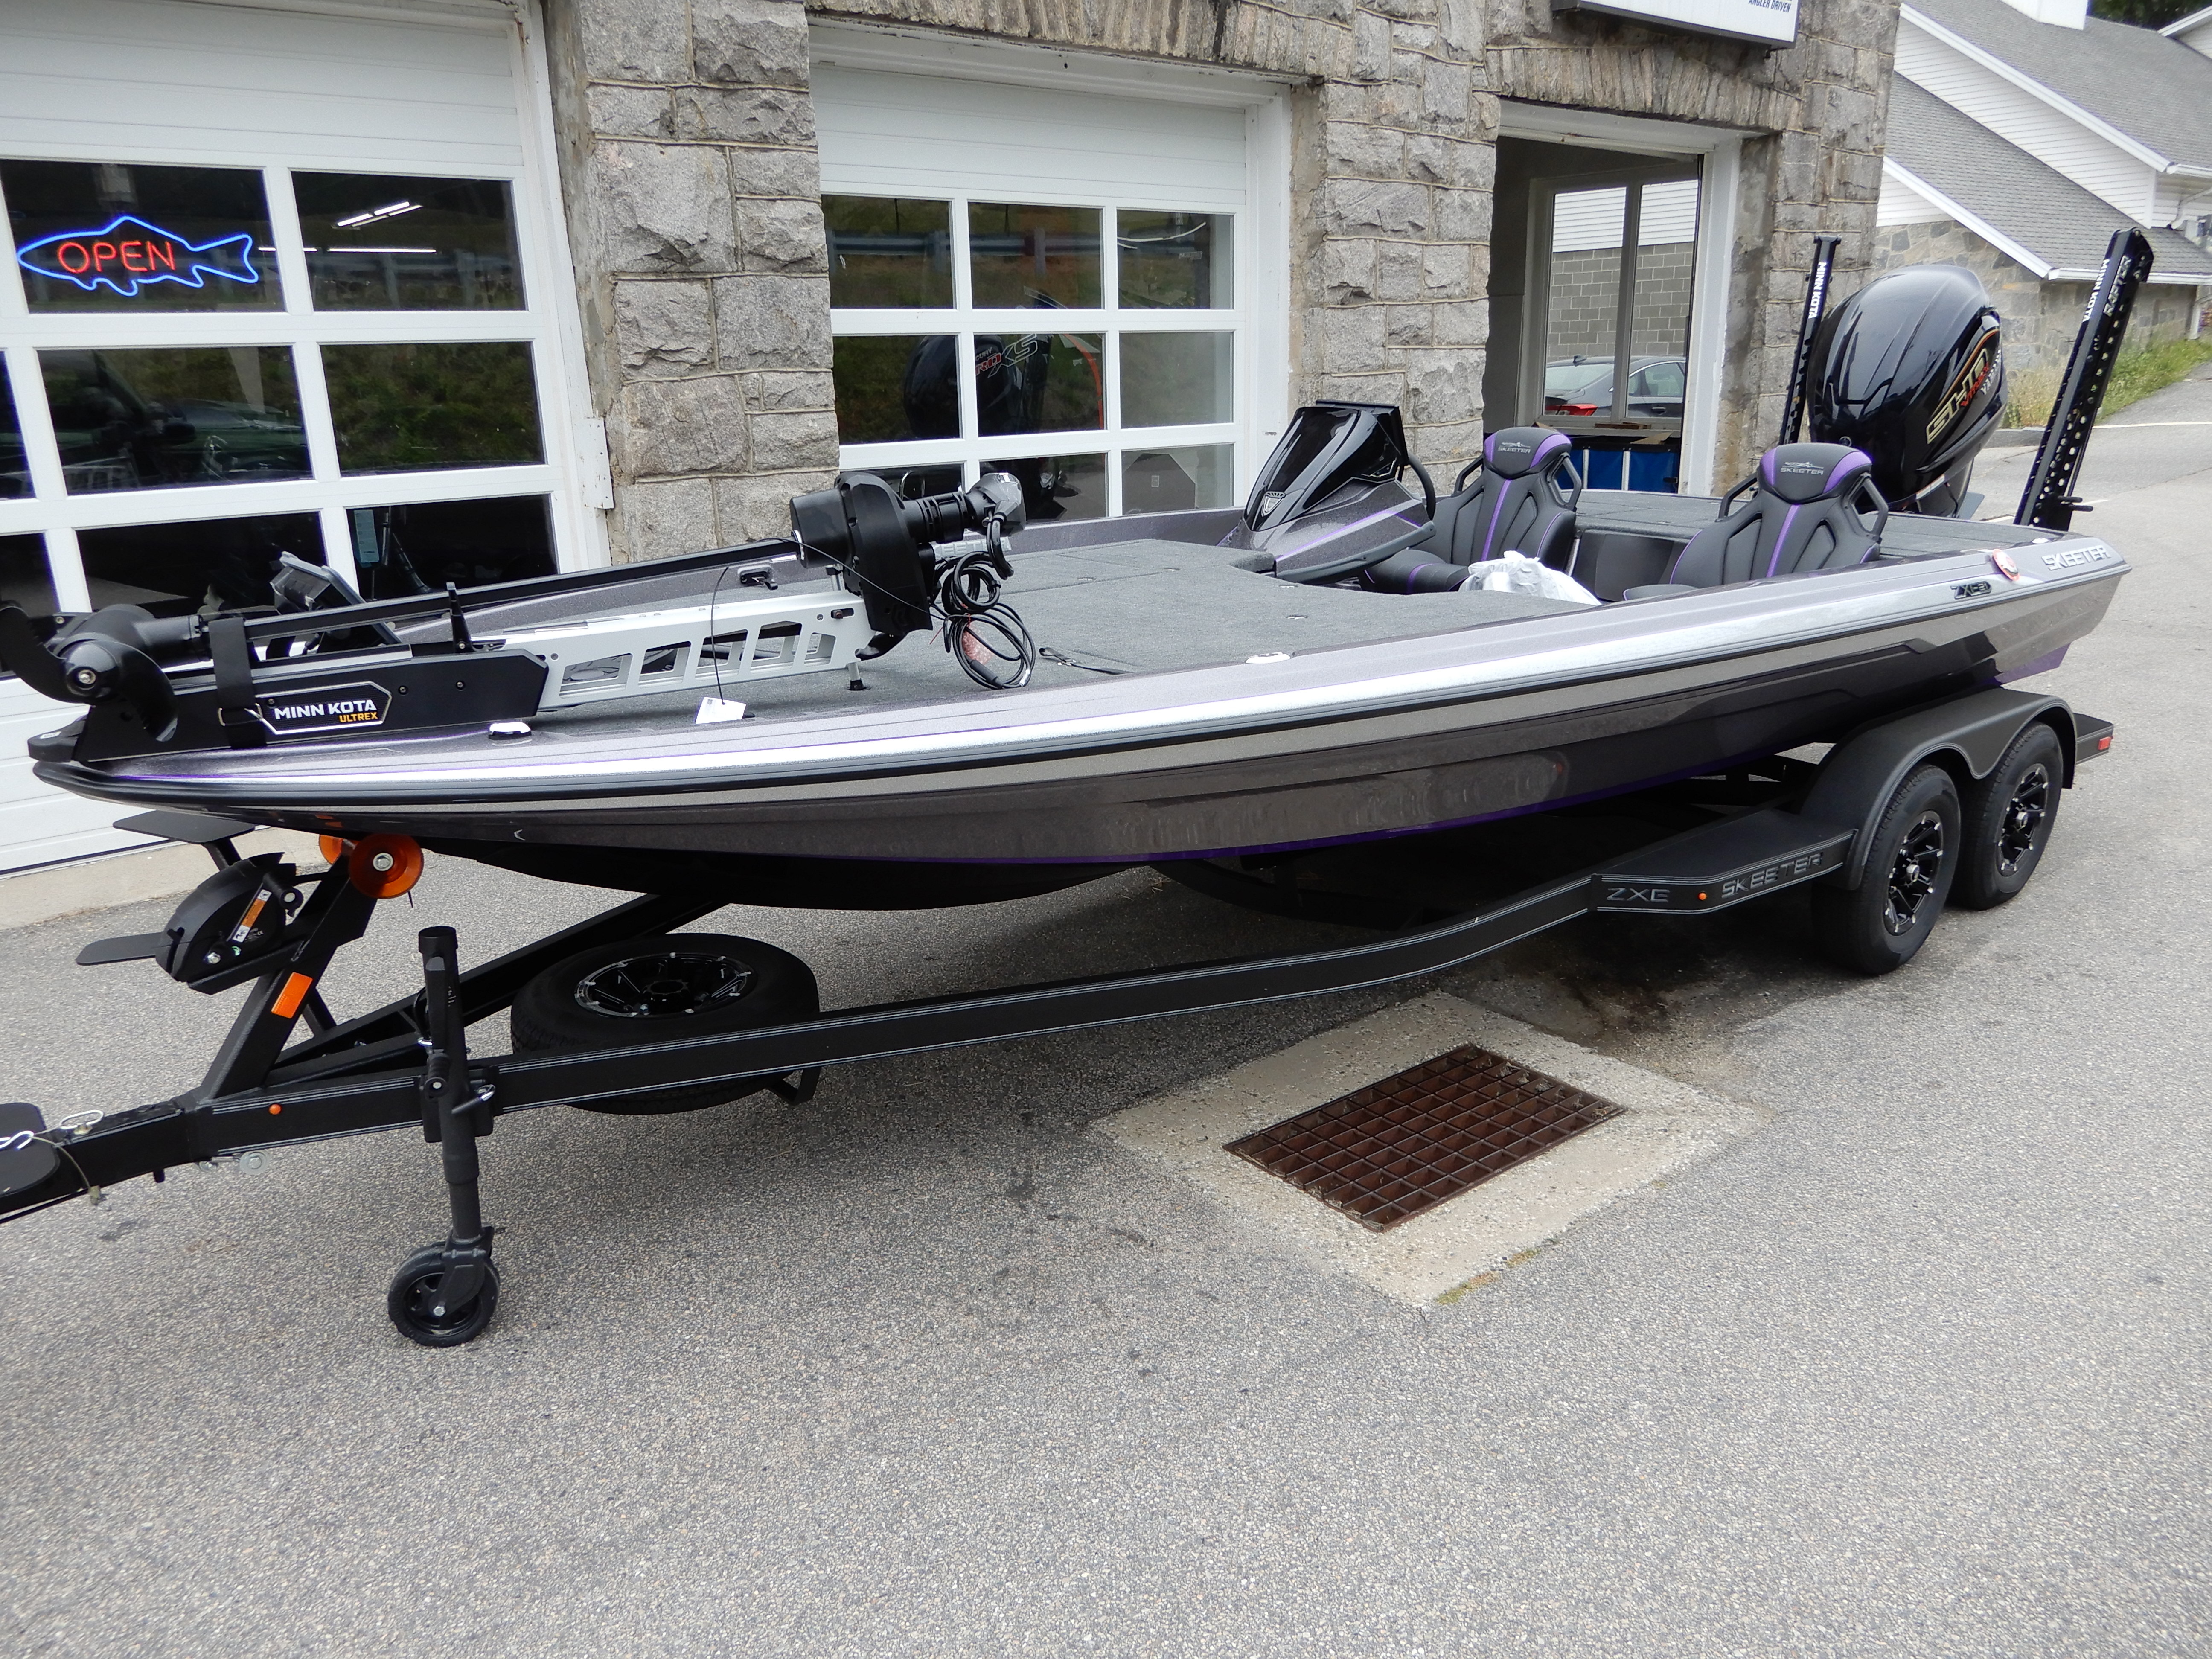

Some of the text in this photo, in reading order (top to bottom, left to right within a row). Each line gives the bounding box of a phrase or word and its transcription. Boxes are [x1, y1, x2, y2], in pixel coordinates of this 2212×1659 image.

[1748, 0, 1791, 12] ANGLER DRIVEN
[57, 240, 175, 274] OPEN
[1808, 262, 1827, 319] MINN KOTA
[2082, 259, 2110, 323] MINN KOTA
[2103, 255, 2132, 317] RAPTOR
[1780, 467, 1824, 476] SKEETER
[2041, 544, 2111, 571] SKEETER
[274, 699, 377, 720] MINN KOTA
[339, 712, 378, 723] ULTREX
[1721, 852, 1823, 899] SKEETER
[1607, 887, 1671, 903] ZXE
